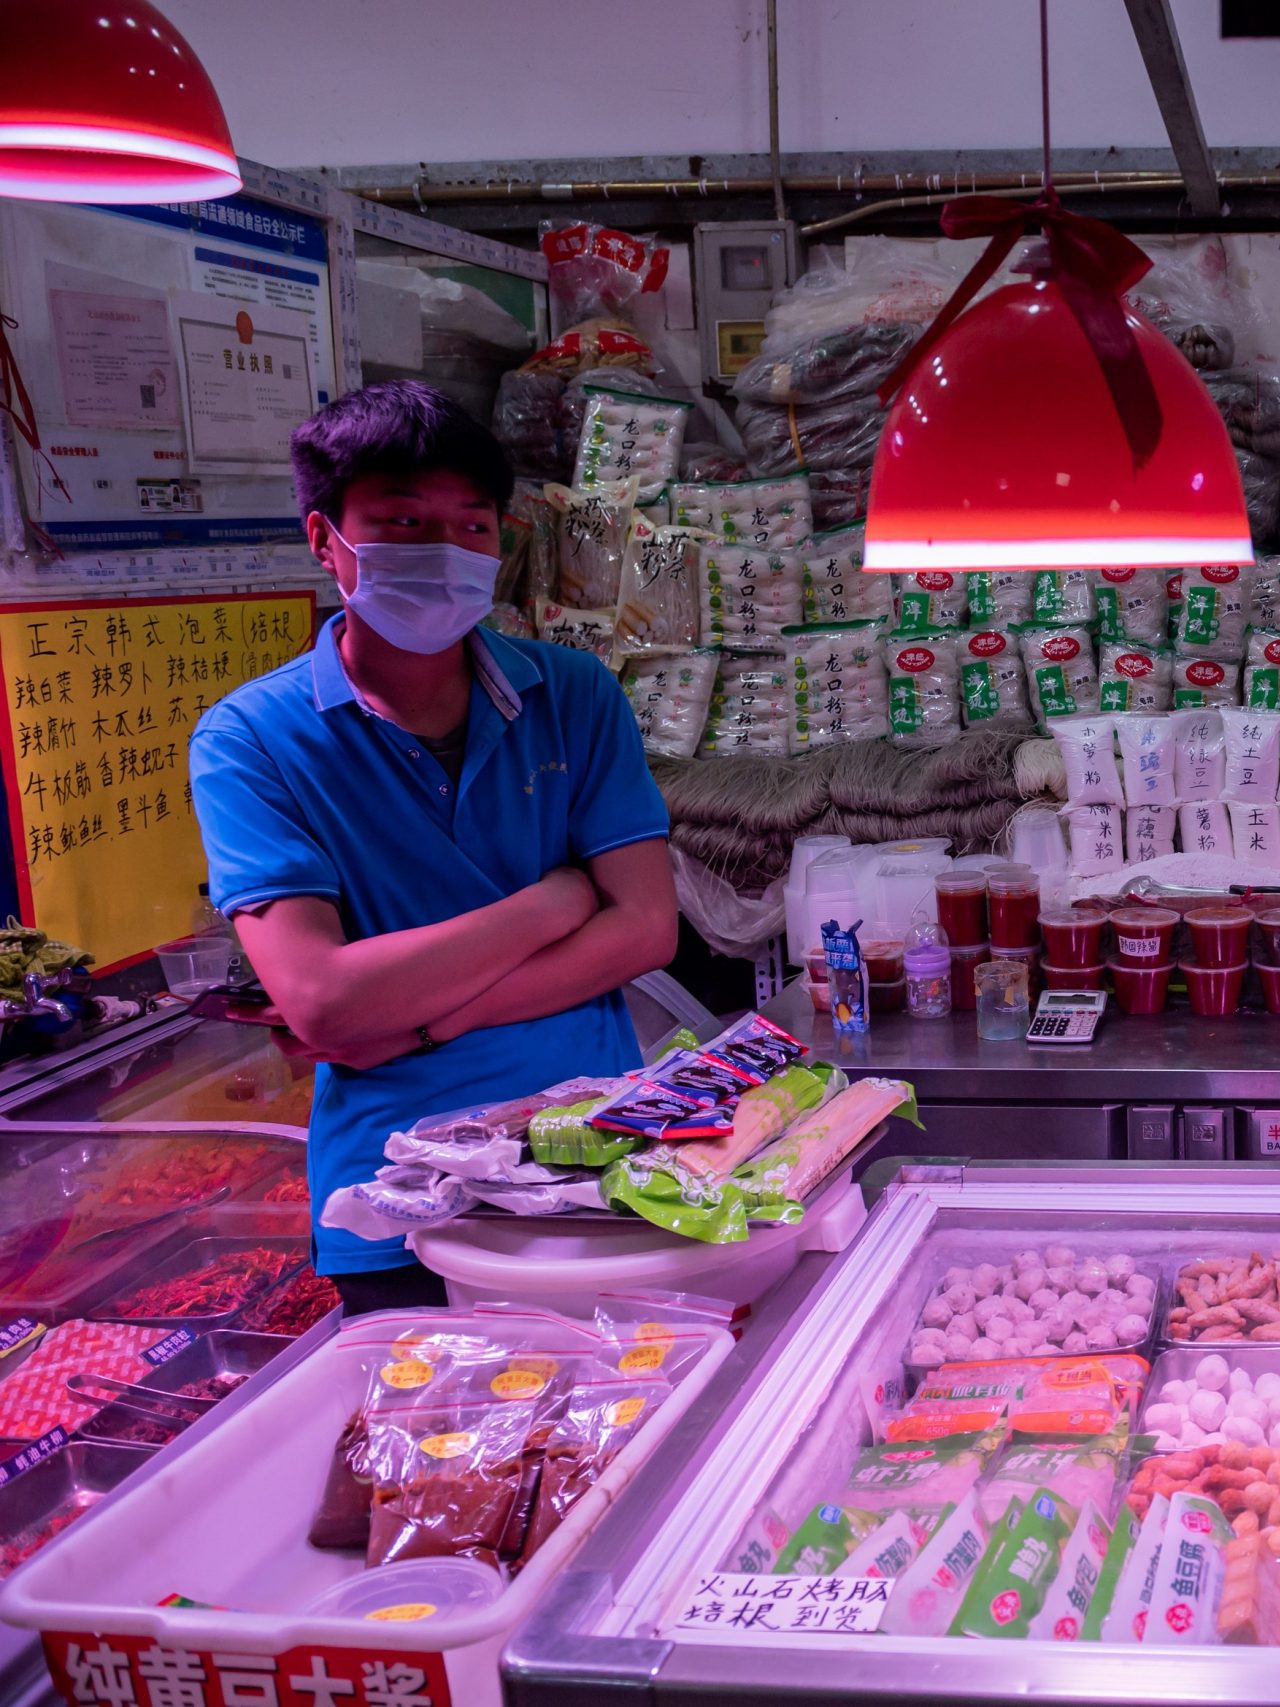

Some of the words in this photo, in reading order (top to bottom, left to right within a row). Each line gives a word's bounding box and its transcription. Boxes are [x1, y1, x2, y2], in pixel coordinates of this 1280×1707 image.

[223, 349, 273, 375] 营业执照
[738, 560, 760, 636] 龙口粉丝
[15, 672, 74, 709] 辣白菜
[92, 661, 153, 698] 辣罗卜
[167, 654, 232, 688] 辣桔梗
[735, 676, 759, 746] 龙口粉丝
[824, 653, 848, 734] 龙口粉丝
[18, 717, 76, 757] 辣腐竹
[91, 707, 157, 743] 木瓜丝
[1239, 724, 1262, 786] 纯土豆
[24, 760, 92, 811] 牛板筋
[97, 744, 179, 787] 香辣蚬子
[1248, 808, 1269, 851] 玉米
[1170, 1538, 1204, 1598] 鱼豆腐
[684, 1601, 780, 1631] 培根
